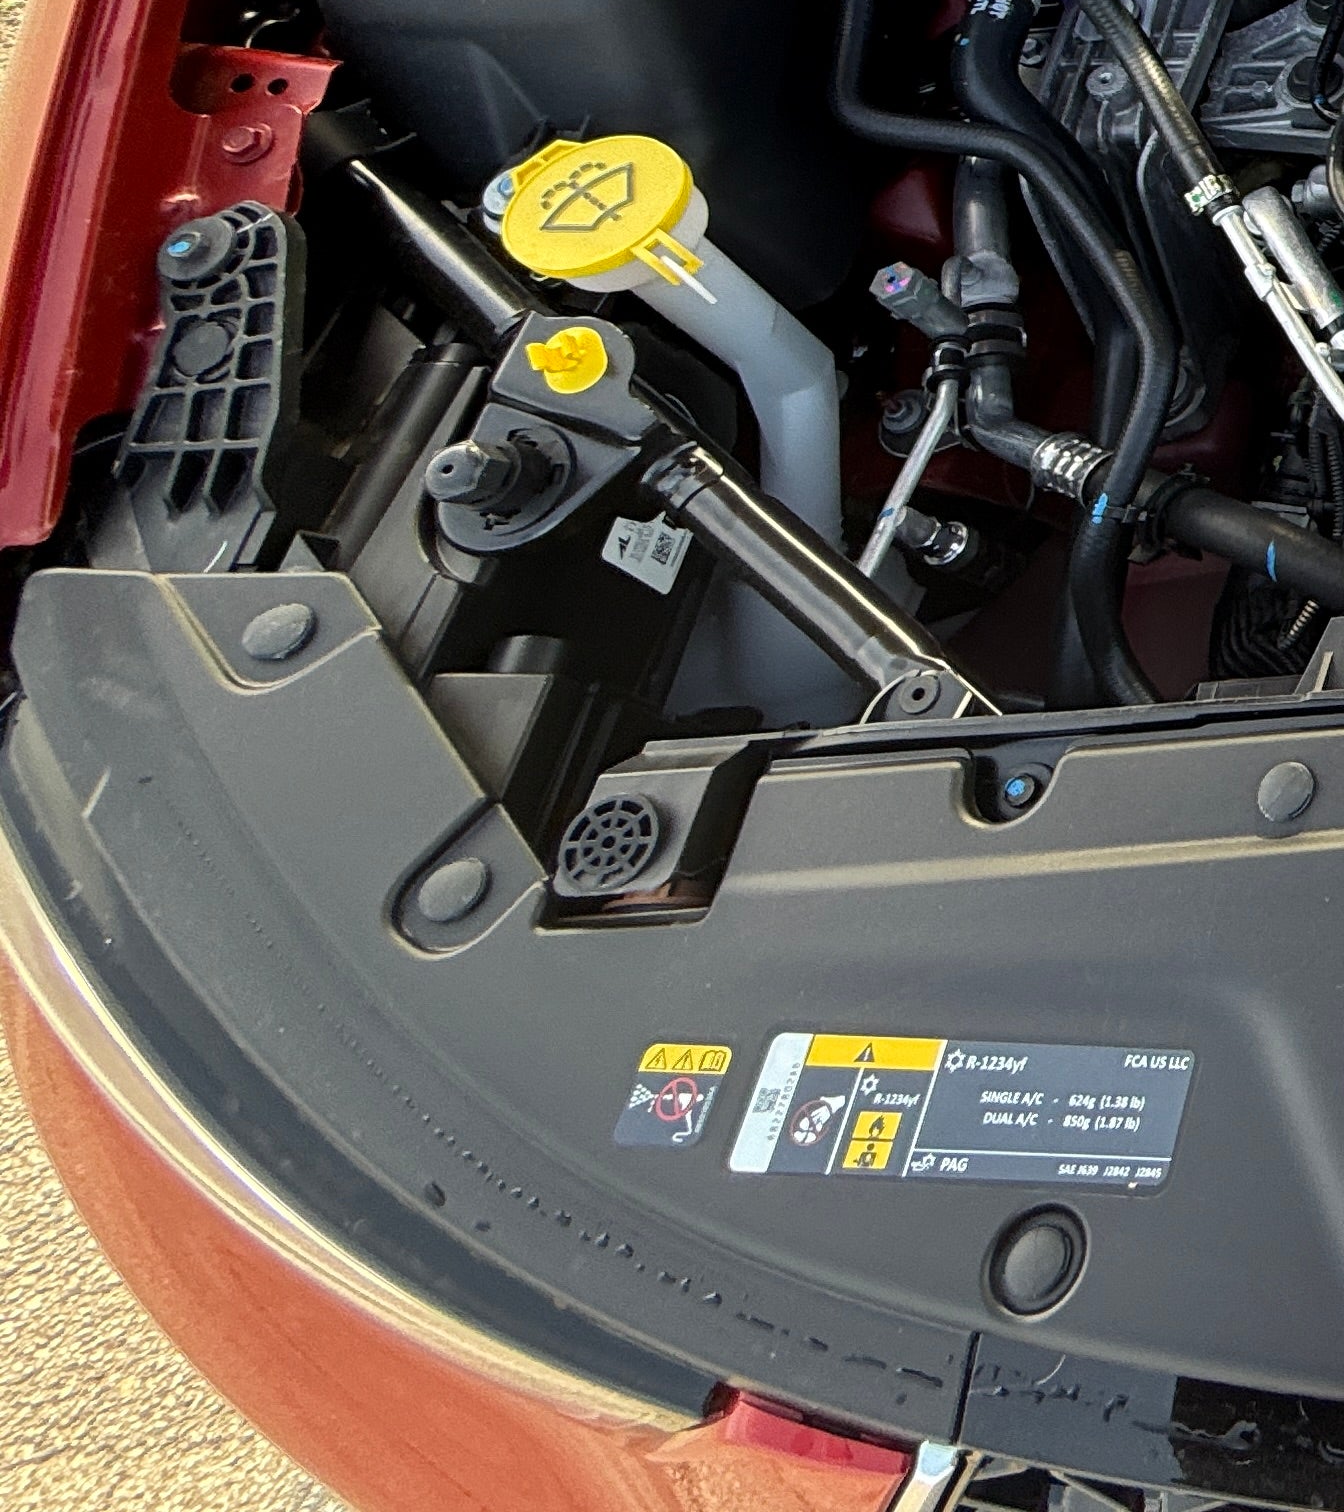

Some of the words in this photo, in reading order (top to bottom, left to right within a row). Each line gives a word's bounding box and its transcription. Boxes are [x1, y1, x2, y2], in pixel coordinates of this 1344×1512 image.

[966, 1055, 1029, 1074] R-1234yf
[1124, 1054, 1148, 1068] FCA
[1150, 1055, 1167, 1069] US
[1168, 1056, 1190, 1070] LLC
[873, 1092, 921, 1107] R-1234yf
[980, 1091, 1021, 1104] SINGLE
[1022, 1092, 1044, 1106] A/C
[1068, 1095, 1096, 1109] 624g
[1100, 1095, 1129, 1109] (1.38
[1130, 1096, 1145, 1112] lb)
[982, 1112, 1017, 1125] DUAL
[1017, 1113, 1039, 1127] A/C
[1063, 1116, 1090, 1131] 850g
[1094, 1116, 1123, 1130] (1.87
[1124, 1117, 1141, 1132] lb)
[940, 1157, 969, 1172] PAG
[1058, 1164, 1077, 1175] SAE
[1103, 1165, 1129, 1177] J2842
